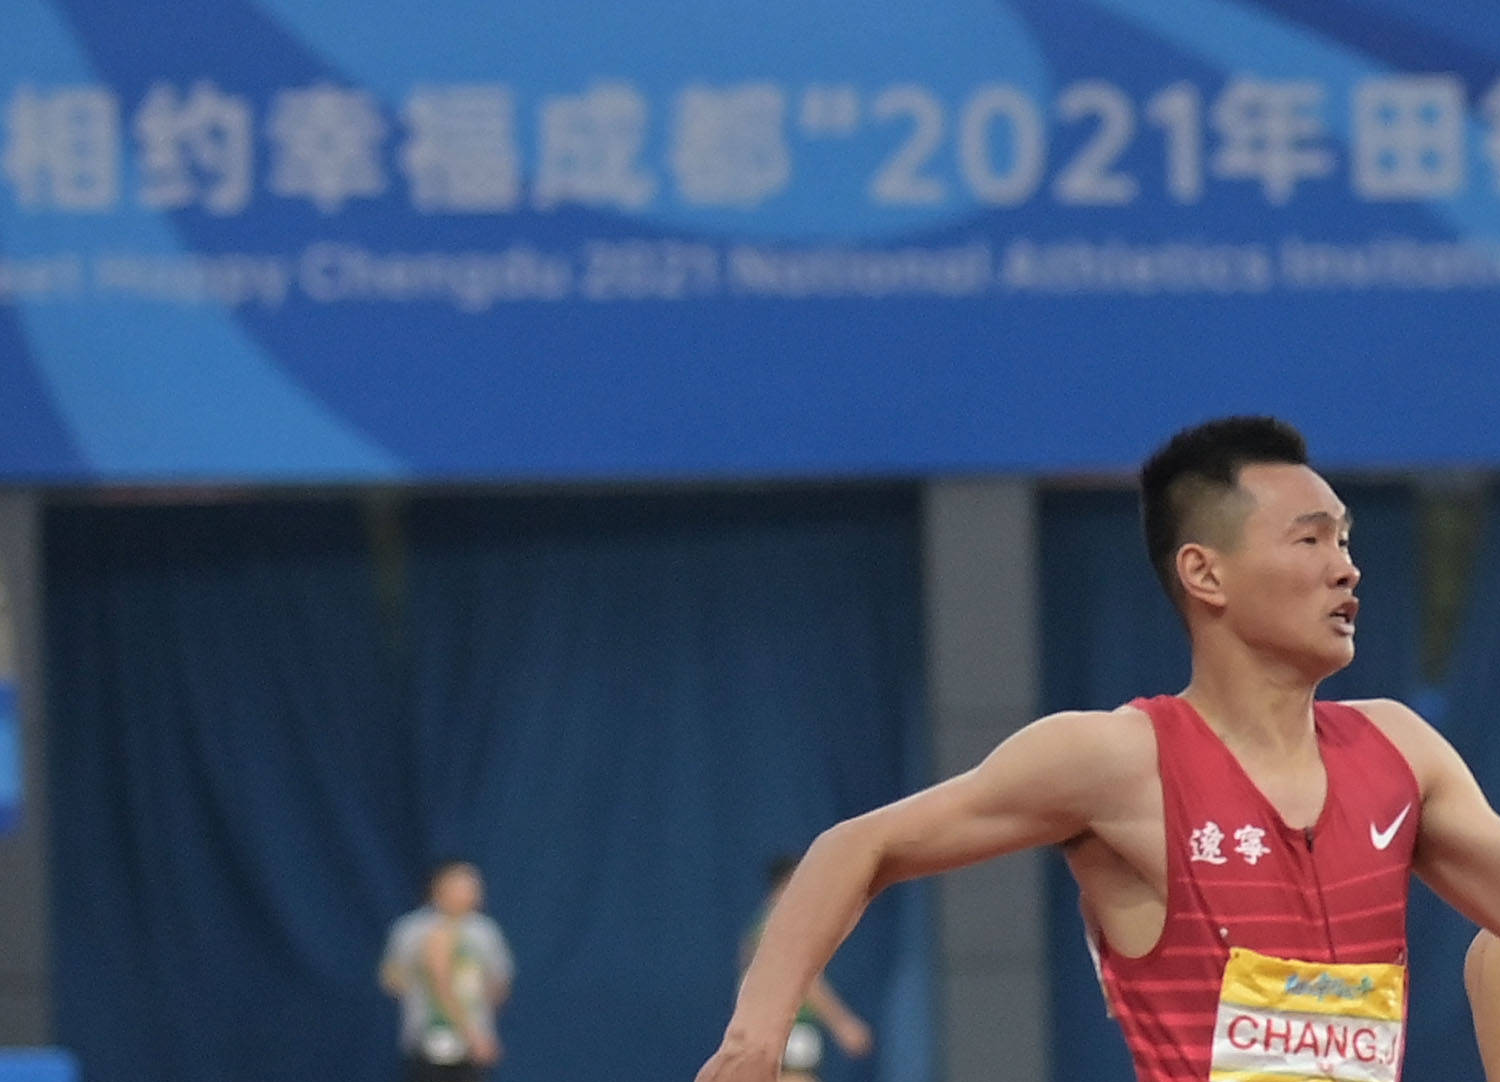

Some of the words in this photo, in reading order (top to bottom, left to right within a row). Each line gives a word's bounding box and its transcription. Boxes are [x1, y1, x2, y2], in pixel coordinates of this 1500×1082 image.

[91, 250, 286, 308] Happy
[301, 242, 574, 312] Chengdu
[582, 240, 715, 300] 2021
[727, 241, 990, 299] National
[1005, 236, 1272, 293] Athletics
